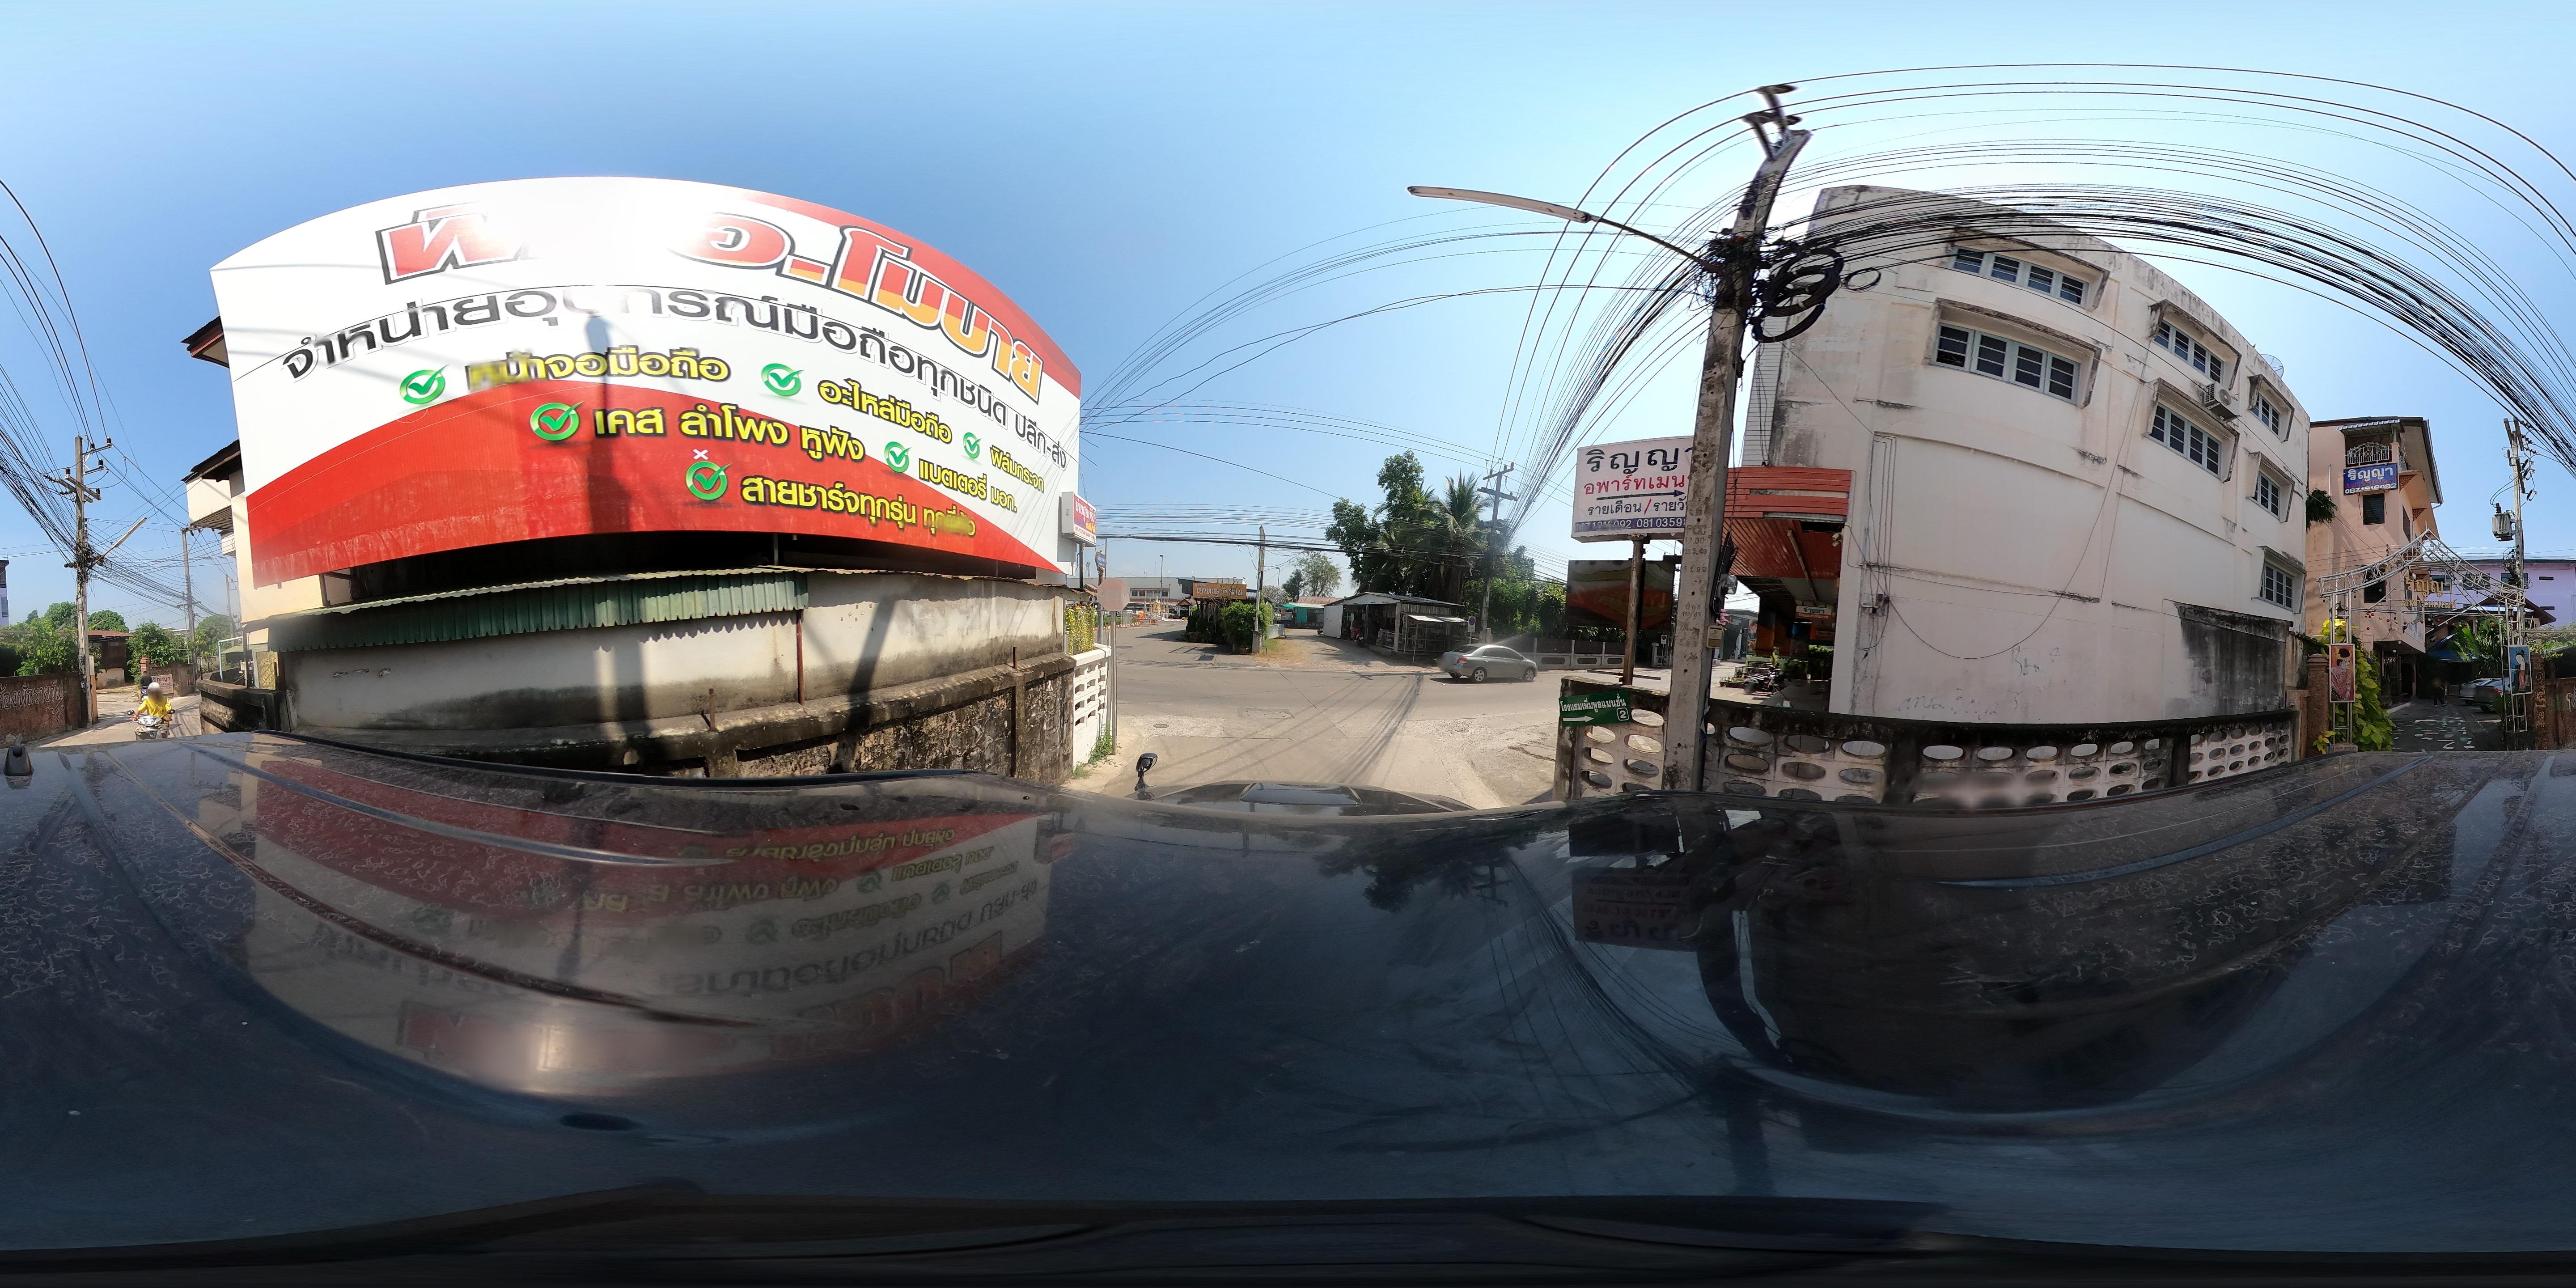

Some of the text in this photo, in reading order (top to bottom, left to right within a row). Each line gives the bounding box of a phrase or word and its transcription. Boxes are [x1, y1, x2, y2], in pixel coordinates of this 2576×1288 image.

[594, 406, 666, 437] เคส
[678, 403, 790, 447] ลำโพง
[800, 425, 866, 462] หูฟัง
[1584, 474, 1690, 495] อพาร์ทเมน
[1619, 710, 1627, 718] 2
